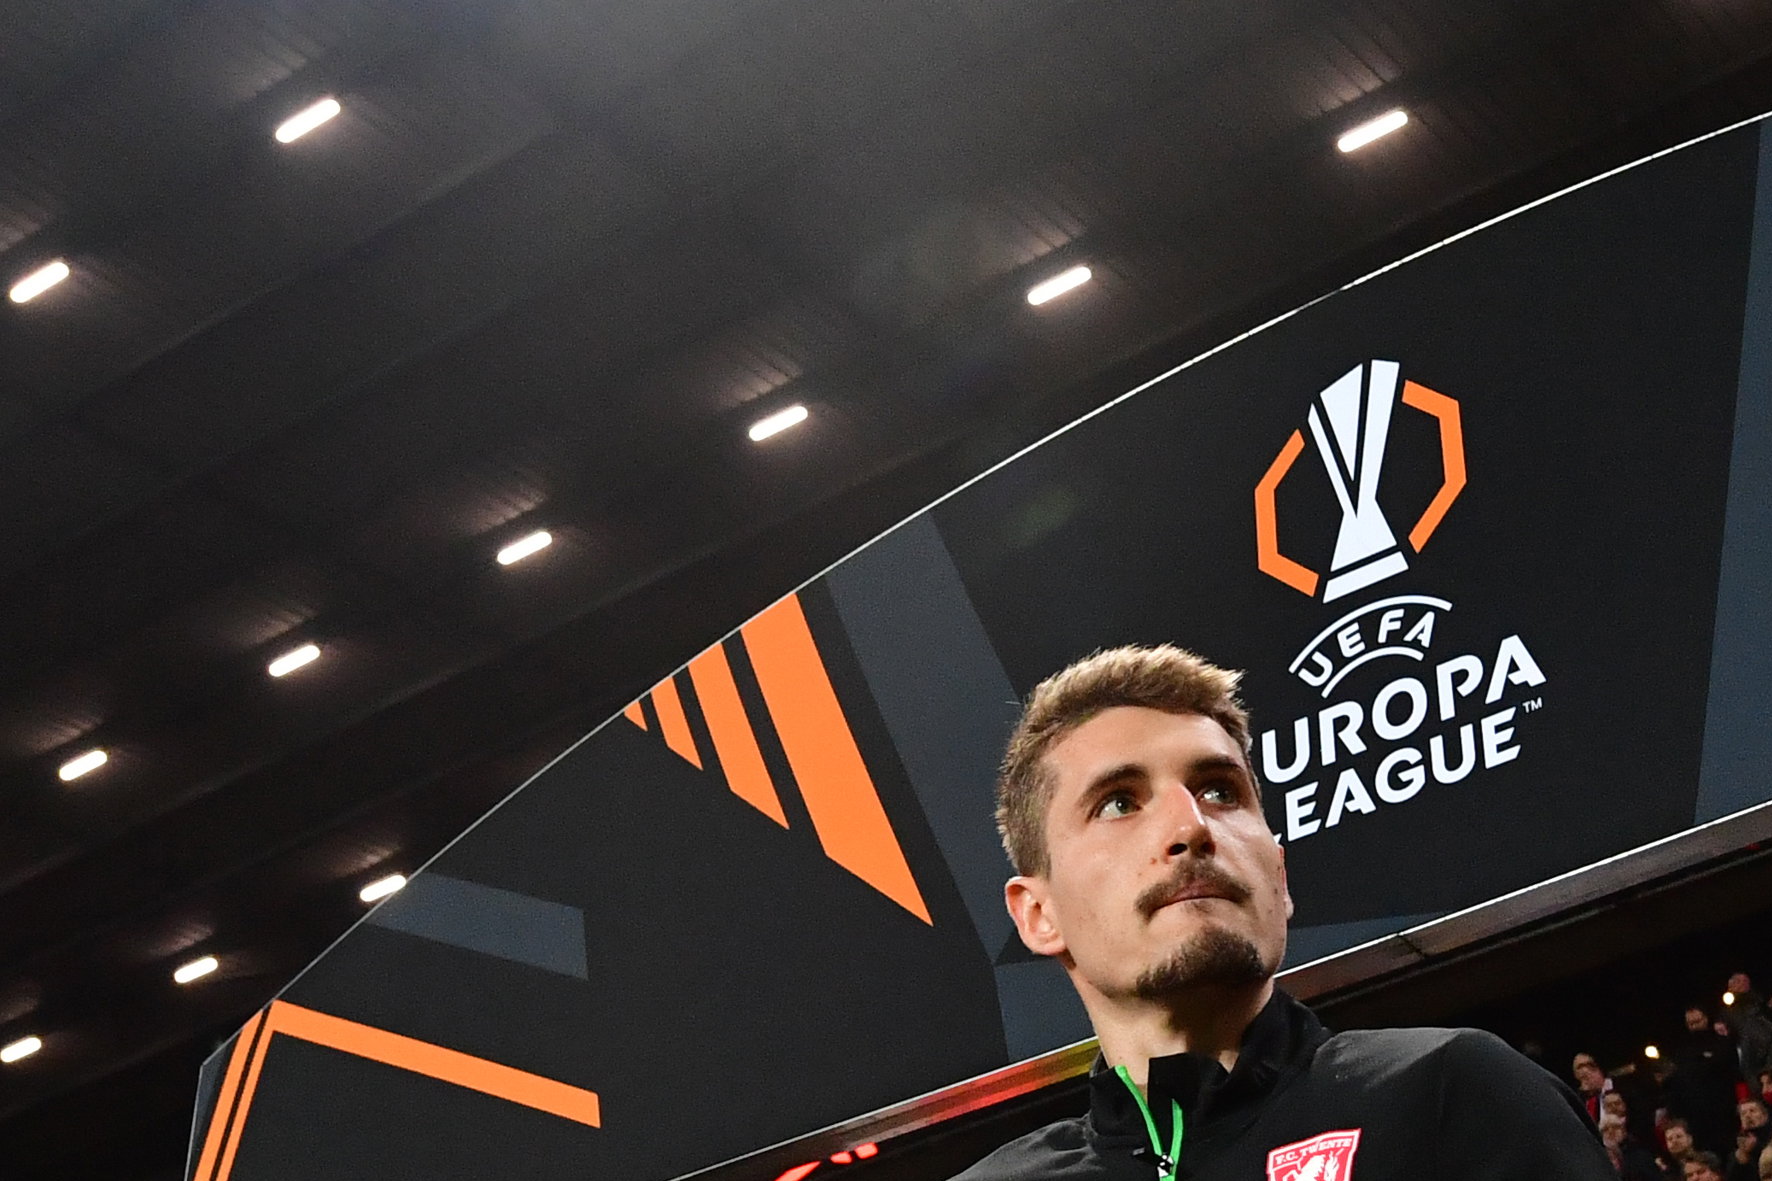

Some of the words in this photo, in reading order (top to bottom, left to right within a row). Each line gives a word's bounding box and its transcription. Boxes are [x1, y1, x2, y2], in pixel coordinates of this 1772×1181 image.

[1298, 608, 1436, 688] UEFA
[1261, 634, 1547, 784] UROPA
[1272, 706, 1522, 850] EAGUE
[1299, 1137, 1353, 1157] TWENTE
